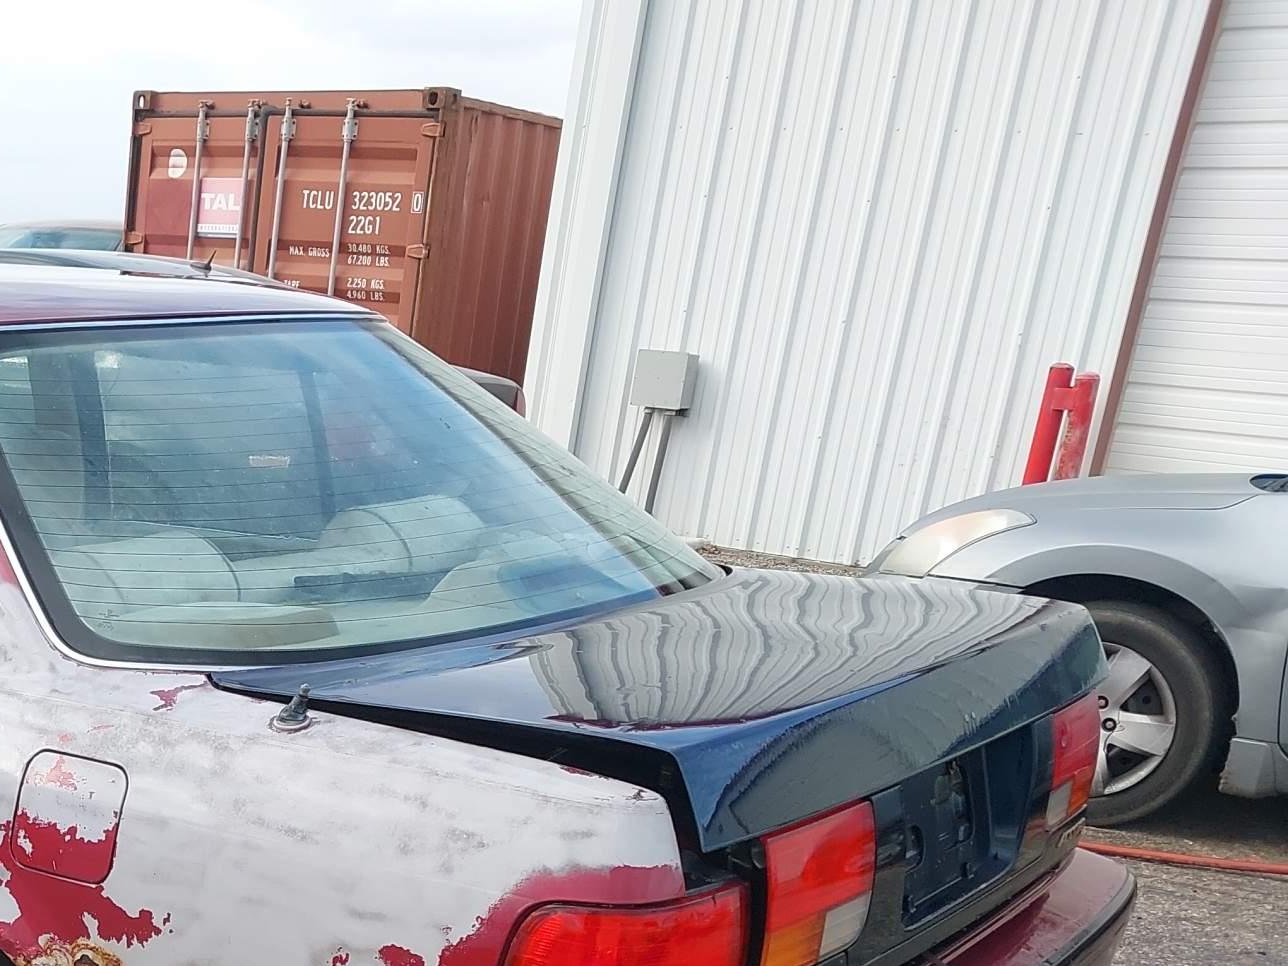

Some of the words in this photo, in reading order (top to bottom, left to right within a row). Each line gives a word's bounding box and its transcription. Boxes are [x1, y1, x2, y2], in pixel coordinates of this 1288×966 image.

[201, 193, 241, 211] TAL
[302, 190, 334, 209] TCLU
[352, 191, 402, 212] 323052
[413, 193, 423, 212] 0
[348, 215, 381, 235] 22G1
[308, 247, 330, 258] GROSS
[347, 255, 372, 266] 67.200
